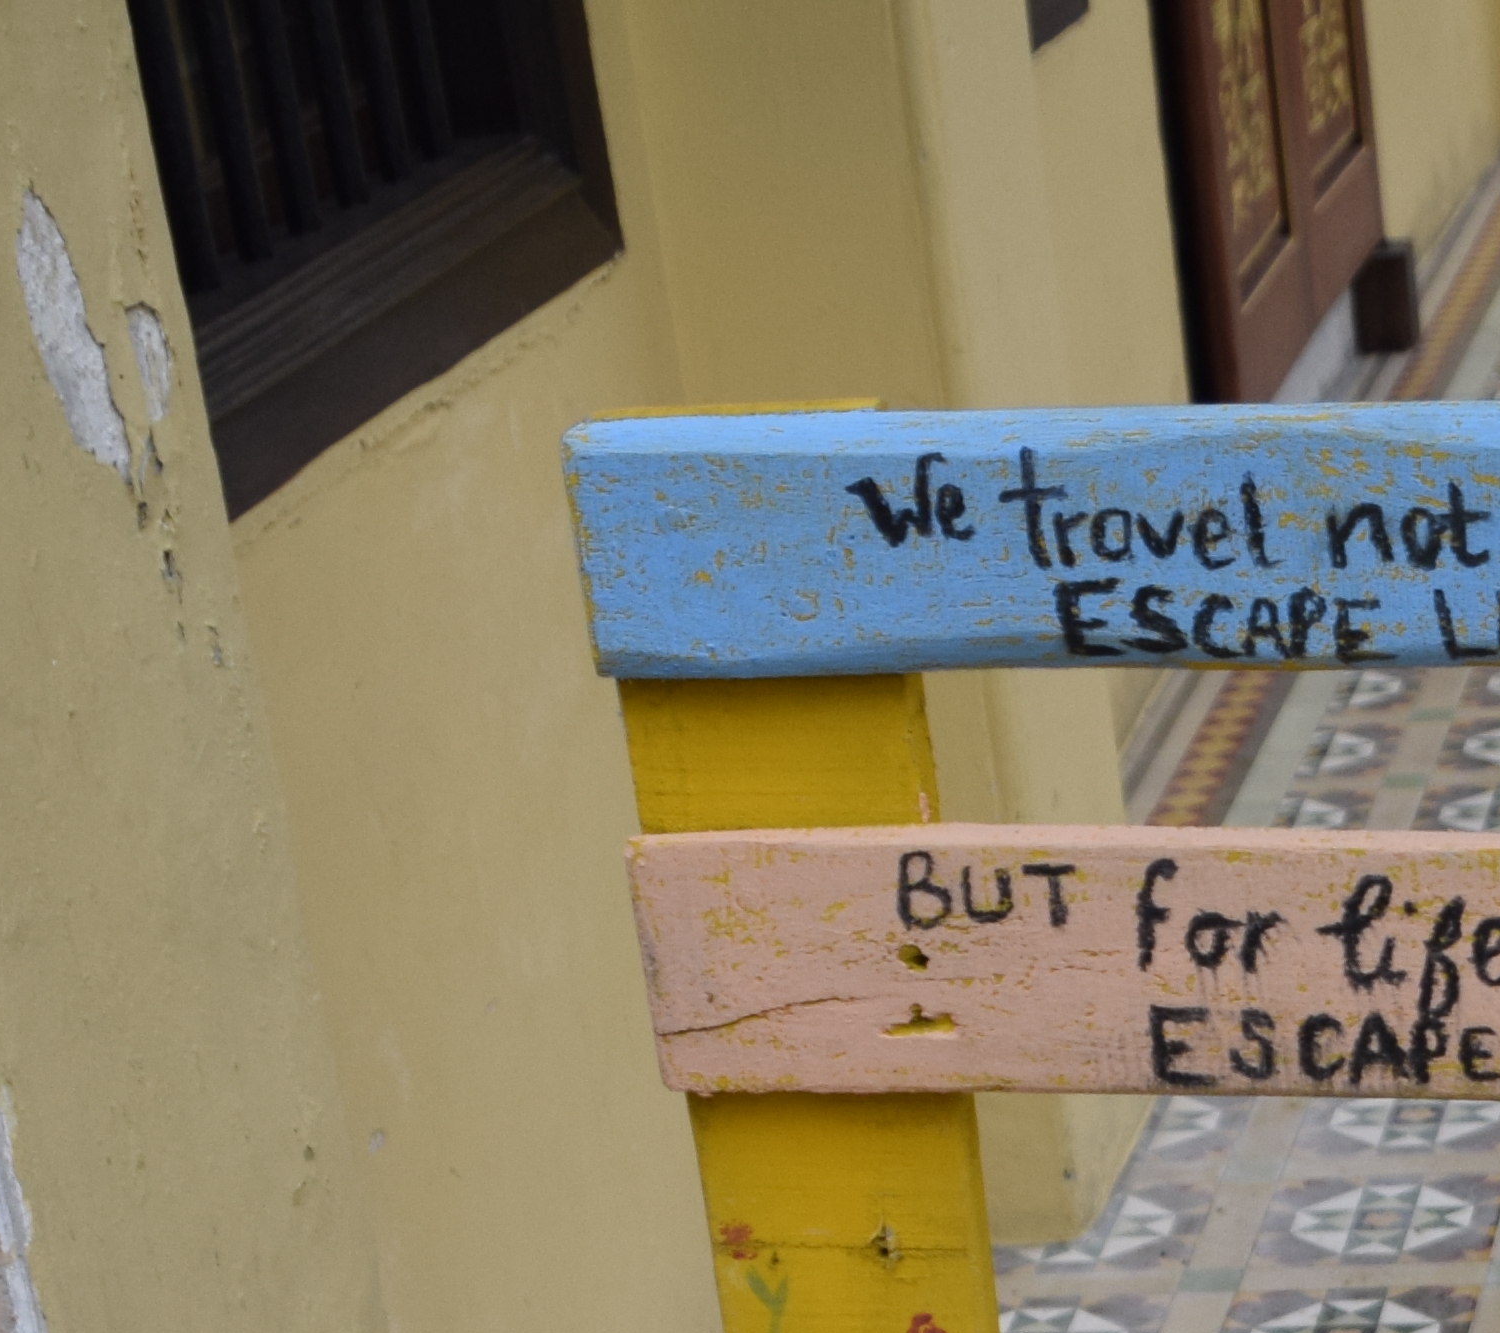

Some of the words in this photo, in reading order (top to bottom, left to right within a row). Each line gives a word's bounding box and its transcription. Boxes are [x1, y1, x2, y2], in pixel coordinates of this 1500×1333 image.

[845, 452, 976, 547] We
[1326, 481, 1491, 570] not
[1053, 576, 1398, 662] ESCAPE
[896, 850, 1077, 930] BUT
[1136, 857, 1288, 973] for
